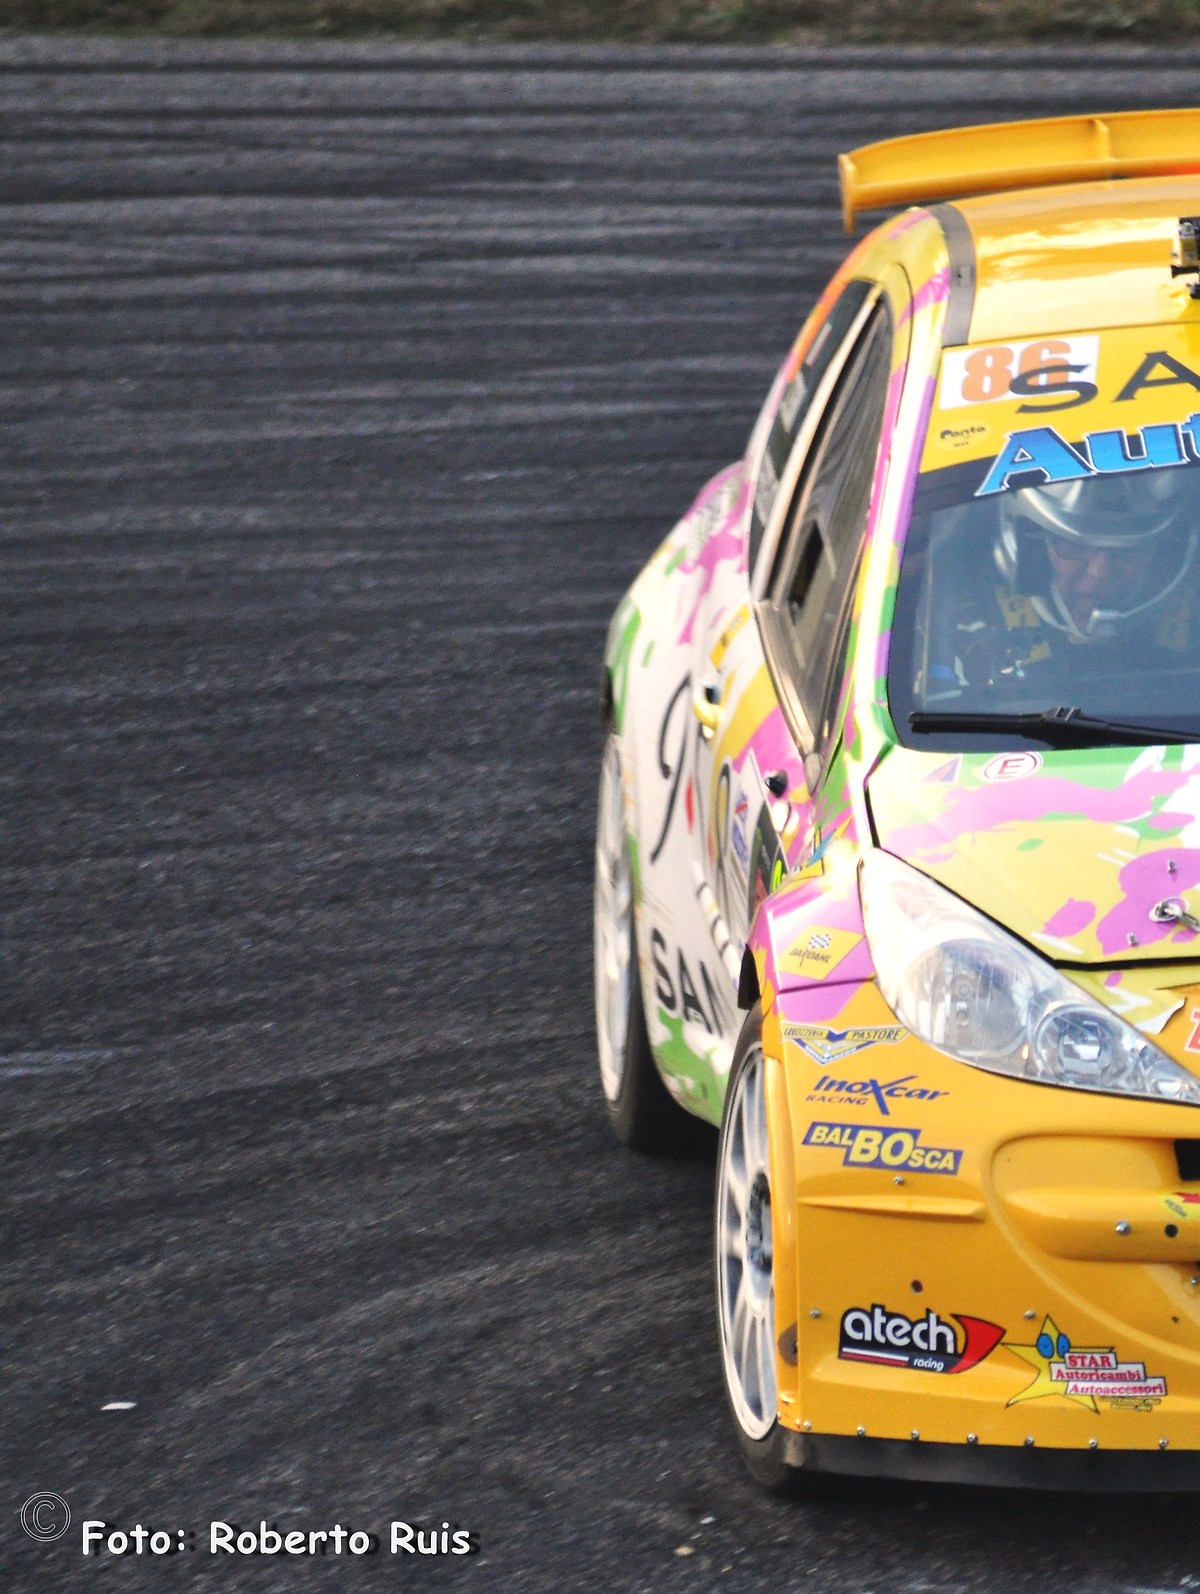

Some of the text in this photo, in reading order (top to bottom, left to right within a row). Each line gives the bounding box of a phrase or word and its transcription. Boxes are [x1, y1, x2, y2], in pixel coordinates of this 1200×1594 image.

[961, 340, 1074, 402] 86
[852, 1028, 901, 1041] PASTORE
[806, 1094, 869, 1106] RACING
[843, 1304, 956, 1354] atech
[912, 1357, 946, 1372] racing
[1067, 1353, 1113, 1368] STAR
[1055, 1368, 1143, 1382] Autoricambi
[1068, 1382, 1167, 1396] Autoaccessori
